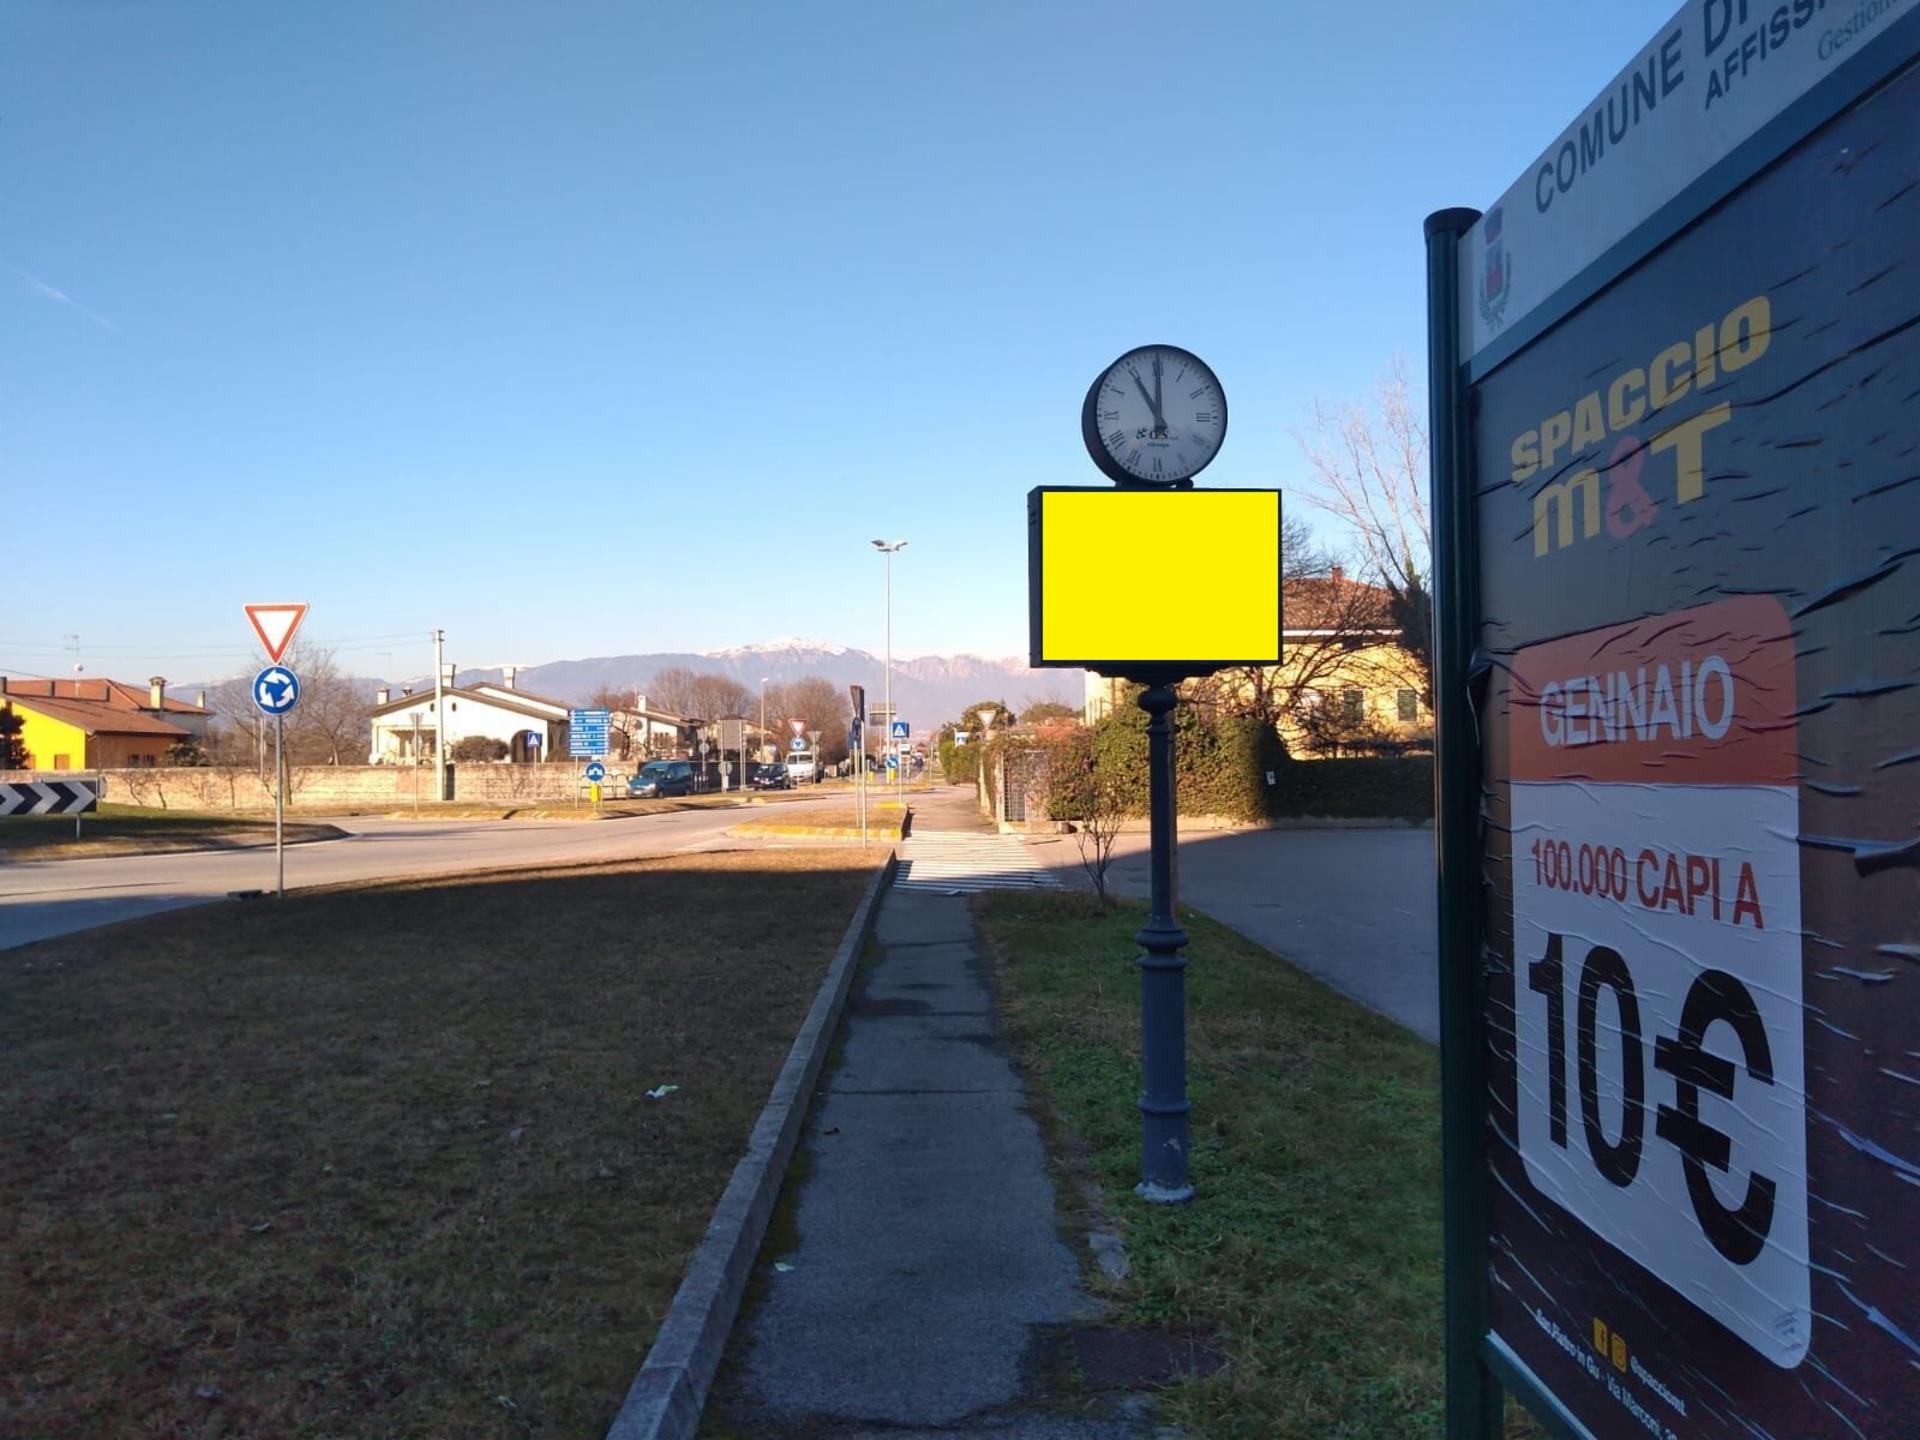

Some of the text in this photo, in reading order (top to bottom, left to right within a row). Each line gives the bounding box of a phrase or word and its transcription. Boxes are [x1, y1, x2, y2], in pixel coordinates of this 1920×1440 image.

[1704, 0, 1825, 110] AFFISS
[1818, 0, 1899, 61] Gestion
[1535, 28, 1684, 214] COMUNE
[1511, 296, 1771, 482] SPACCIO
[1540, 655, 1734, 746] GENNAIO
[1531, 837, 1764, 928] 100.000 CAPI A
[1528, 931, 1777, 1266] 10€
[1606, 1371, 1622, 1401] Via
